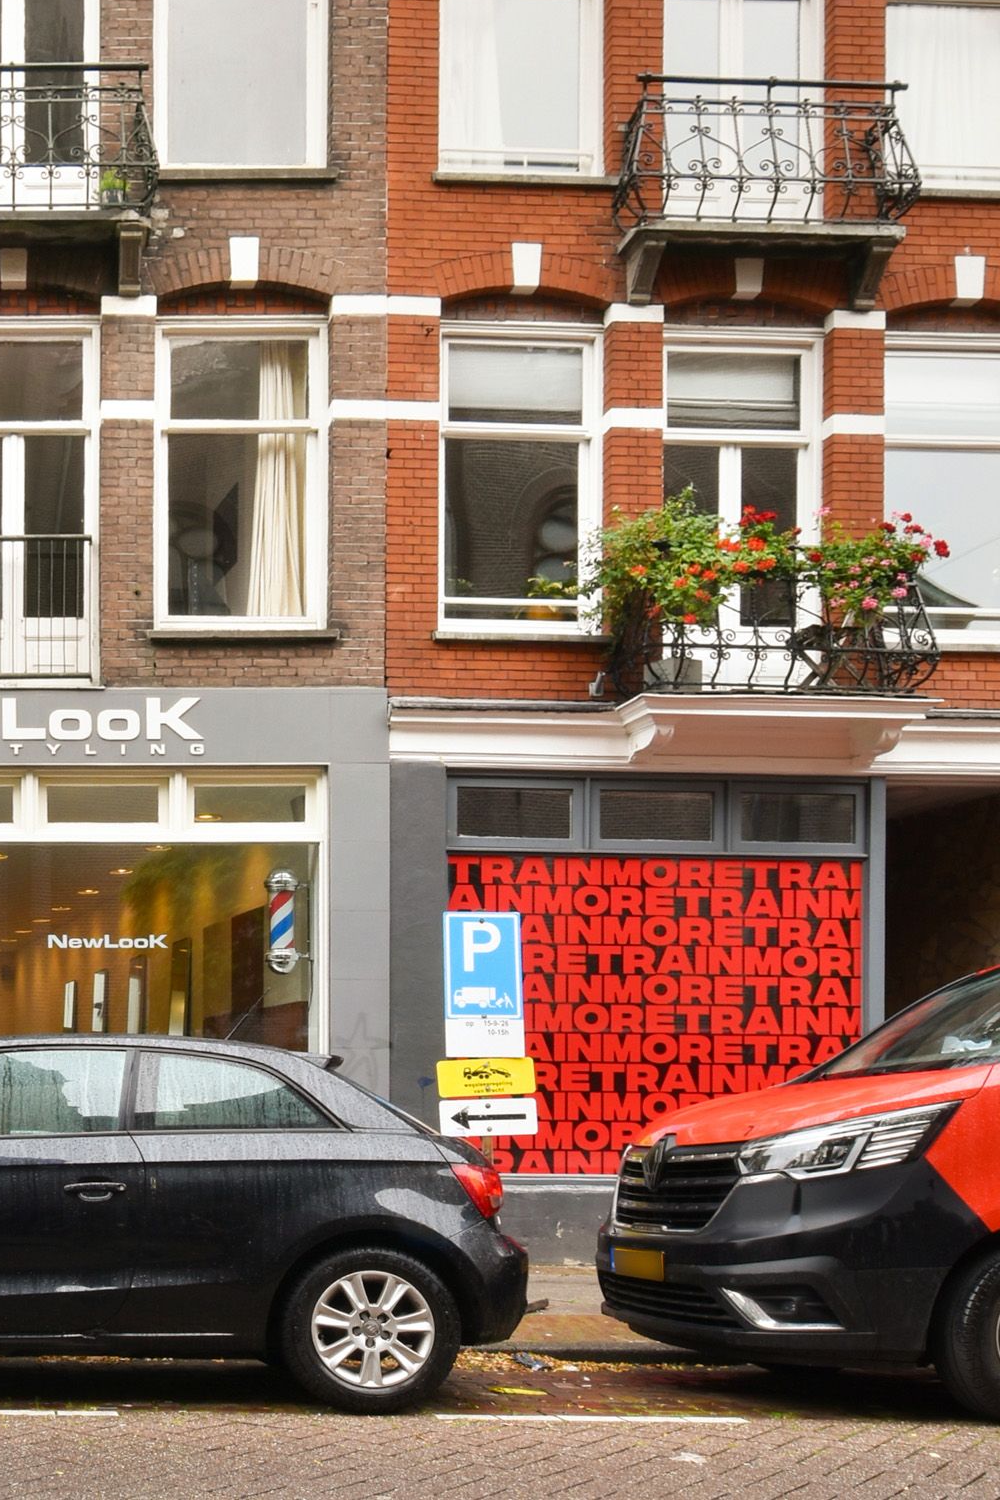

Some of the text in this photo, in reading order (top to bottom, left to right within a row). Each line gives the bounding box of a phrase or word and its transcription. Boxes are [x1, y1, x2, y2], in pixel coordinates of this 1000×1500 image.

[47, 933, 169, 949] NewLooK
[462, 921, 501, 973] P
[522, 943, 861, 977] RETRAINMOR
[524, 1003, 861, 1036] MORETRAINM
[524, 1032, 861, 1065] AINMORETRA
